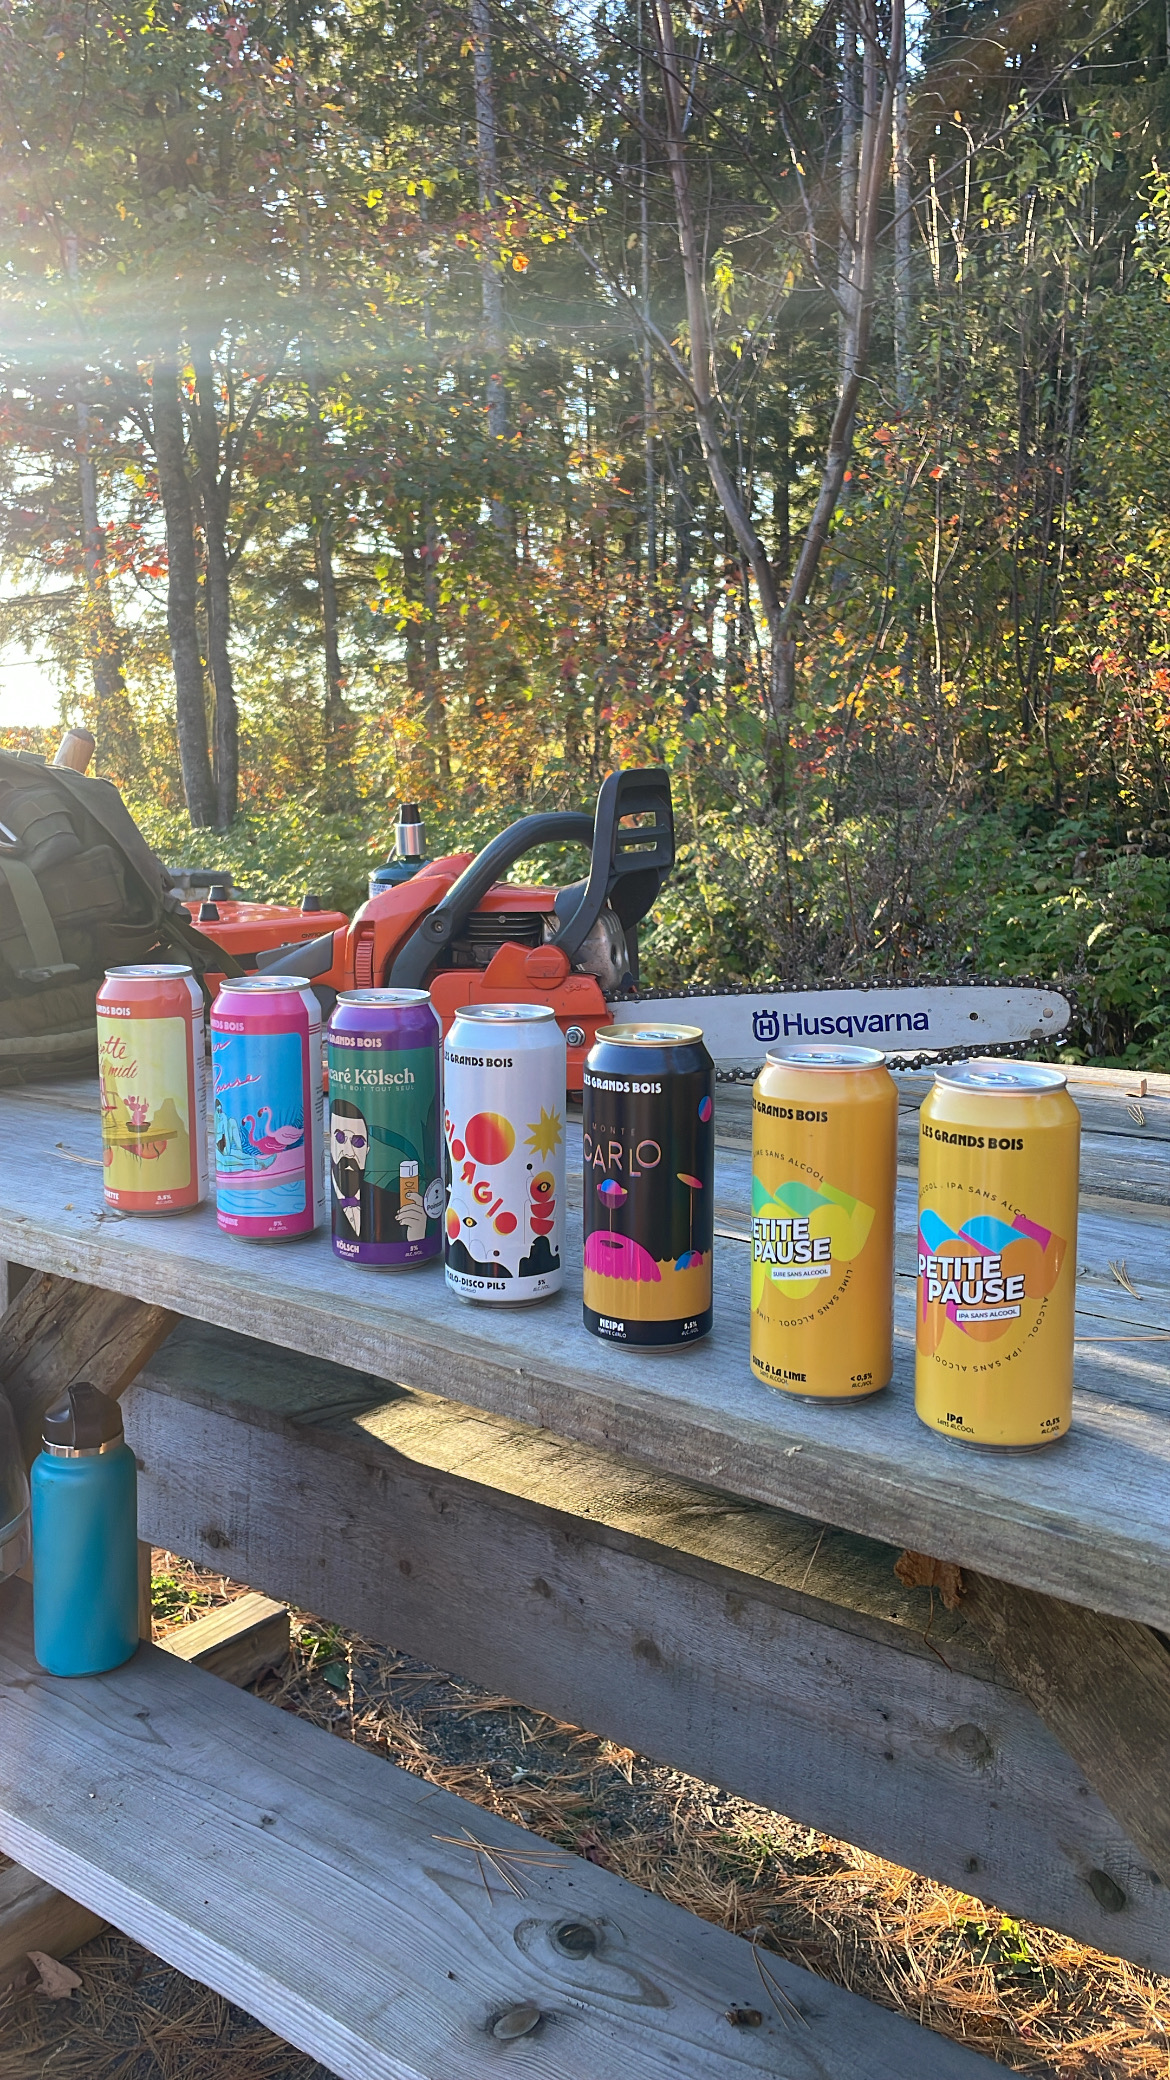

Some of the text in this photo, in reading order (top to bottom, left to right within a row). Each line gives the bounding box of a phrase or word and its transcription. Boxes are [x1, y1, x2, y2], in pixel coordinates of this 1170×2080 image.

[111, 1007, 131, 1016] BOIS
[224, 1021, 244, 1031] BOIS
[783, 1012, 929, 1038] Husqvarna
[356, 1037, 382, 1048] BOIS
[108, 1060, 139, 1078] midi
[450, 1053, 484, 1067] GRANDS
[486, 1058, 513, 1068] BOIS
[354, 1067, 415, 1085] Kölsch
[592, 1076, 630, 1093] GRANDS
[632, 1082, 662, 1094] BOIS
[757, 1102, 793, 1119] GRANDS
[796, 1110, 828, 1122] BOIS
[592, 1122, 635, 1136] MONTE
[922, 1123, 1023, 1150] LES GRANDS BOIS
[583, 1133, 662, 1177] CARLO
[788, 1157, 824, 1183] ALCOOL
[947, 1182, 963, 1190] IPA
[968, 1186, 997, 1202] SANS
[1001, 1200, 1027, 1219] ALCO
[752, 1217, 809, 1241] ETITE
[336, 1240, 360, 1254] KÖLSCH
[754, 1237, 832, 1264] PAUSE
[918, 1253, 1002, 1281] PETITE
[446, 1269, 506, 1290] TALO-DISCO PILS
[928, 1274, 1025, 1305] PAUSE
[779, 1314, 814, 1327] ALCOOL
[958, 1311, 969, 1319] IPA
[990, 1309, 1017, 1317] ALCOOL
[1028, 1296, 1049, 1338] ALCOOL
[1005, 1347, 1022, 1361] IPA
[772, 1366, 781, 1376] LA
[784, 1370, 806, 1382] LIME
[973, 1360, 1002, 1372] SANS
[946, 1413, 963, 1425] IPA
[950, 1423, 975, 1434] ALCOOL
